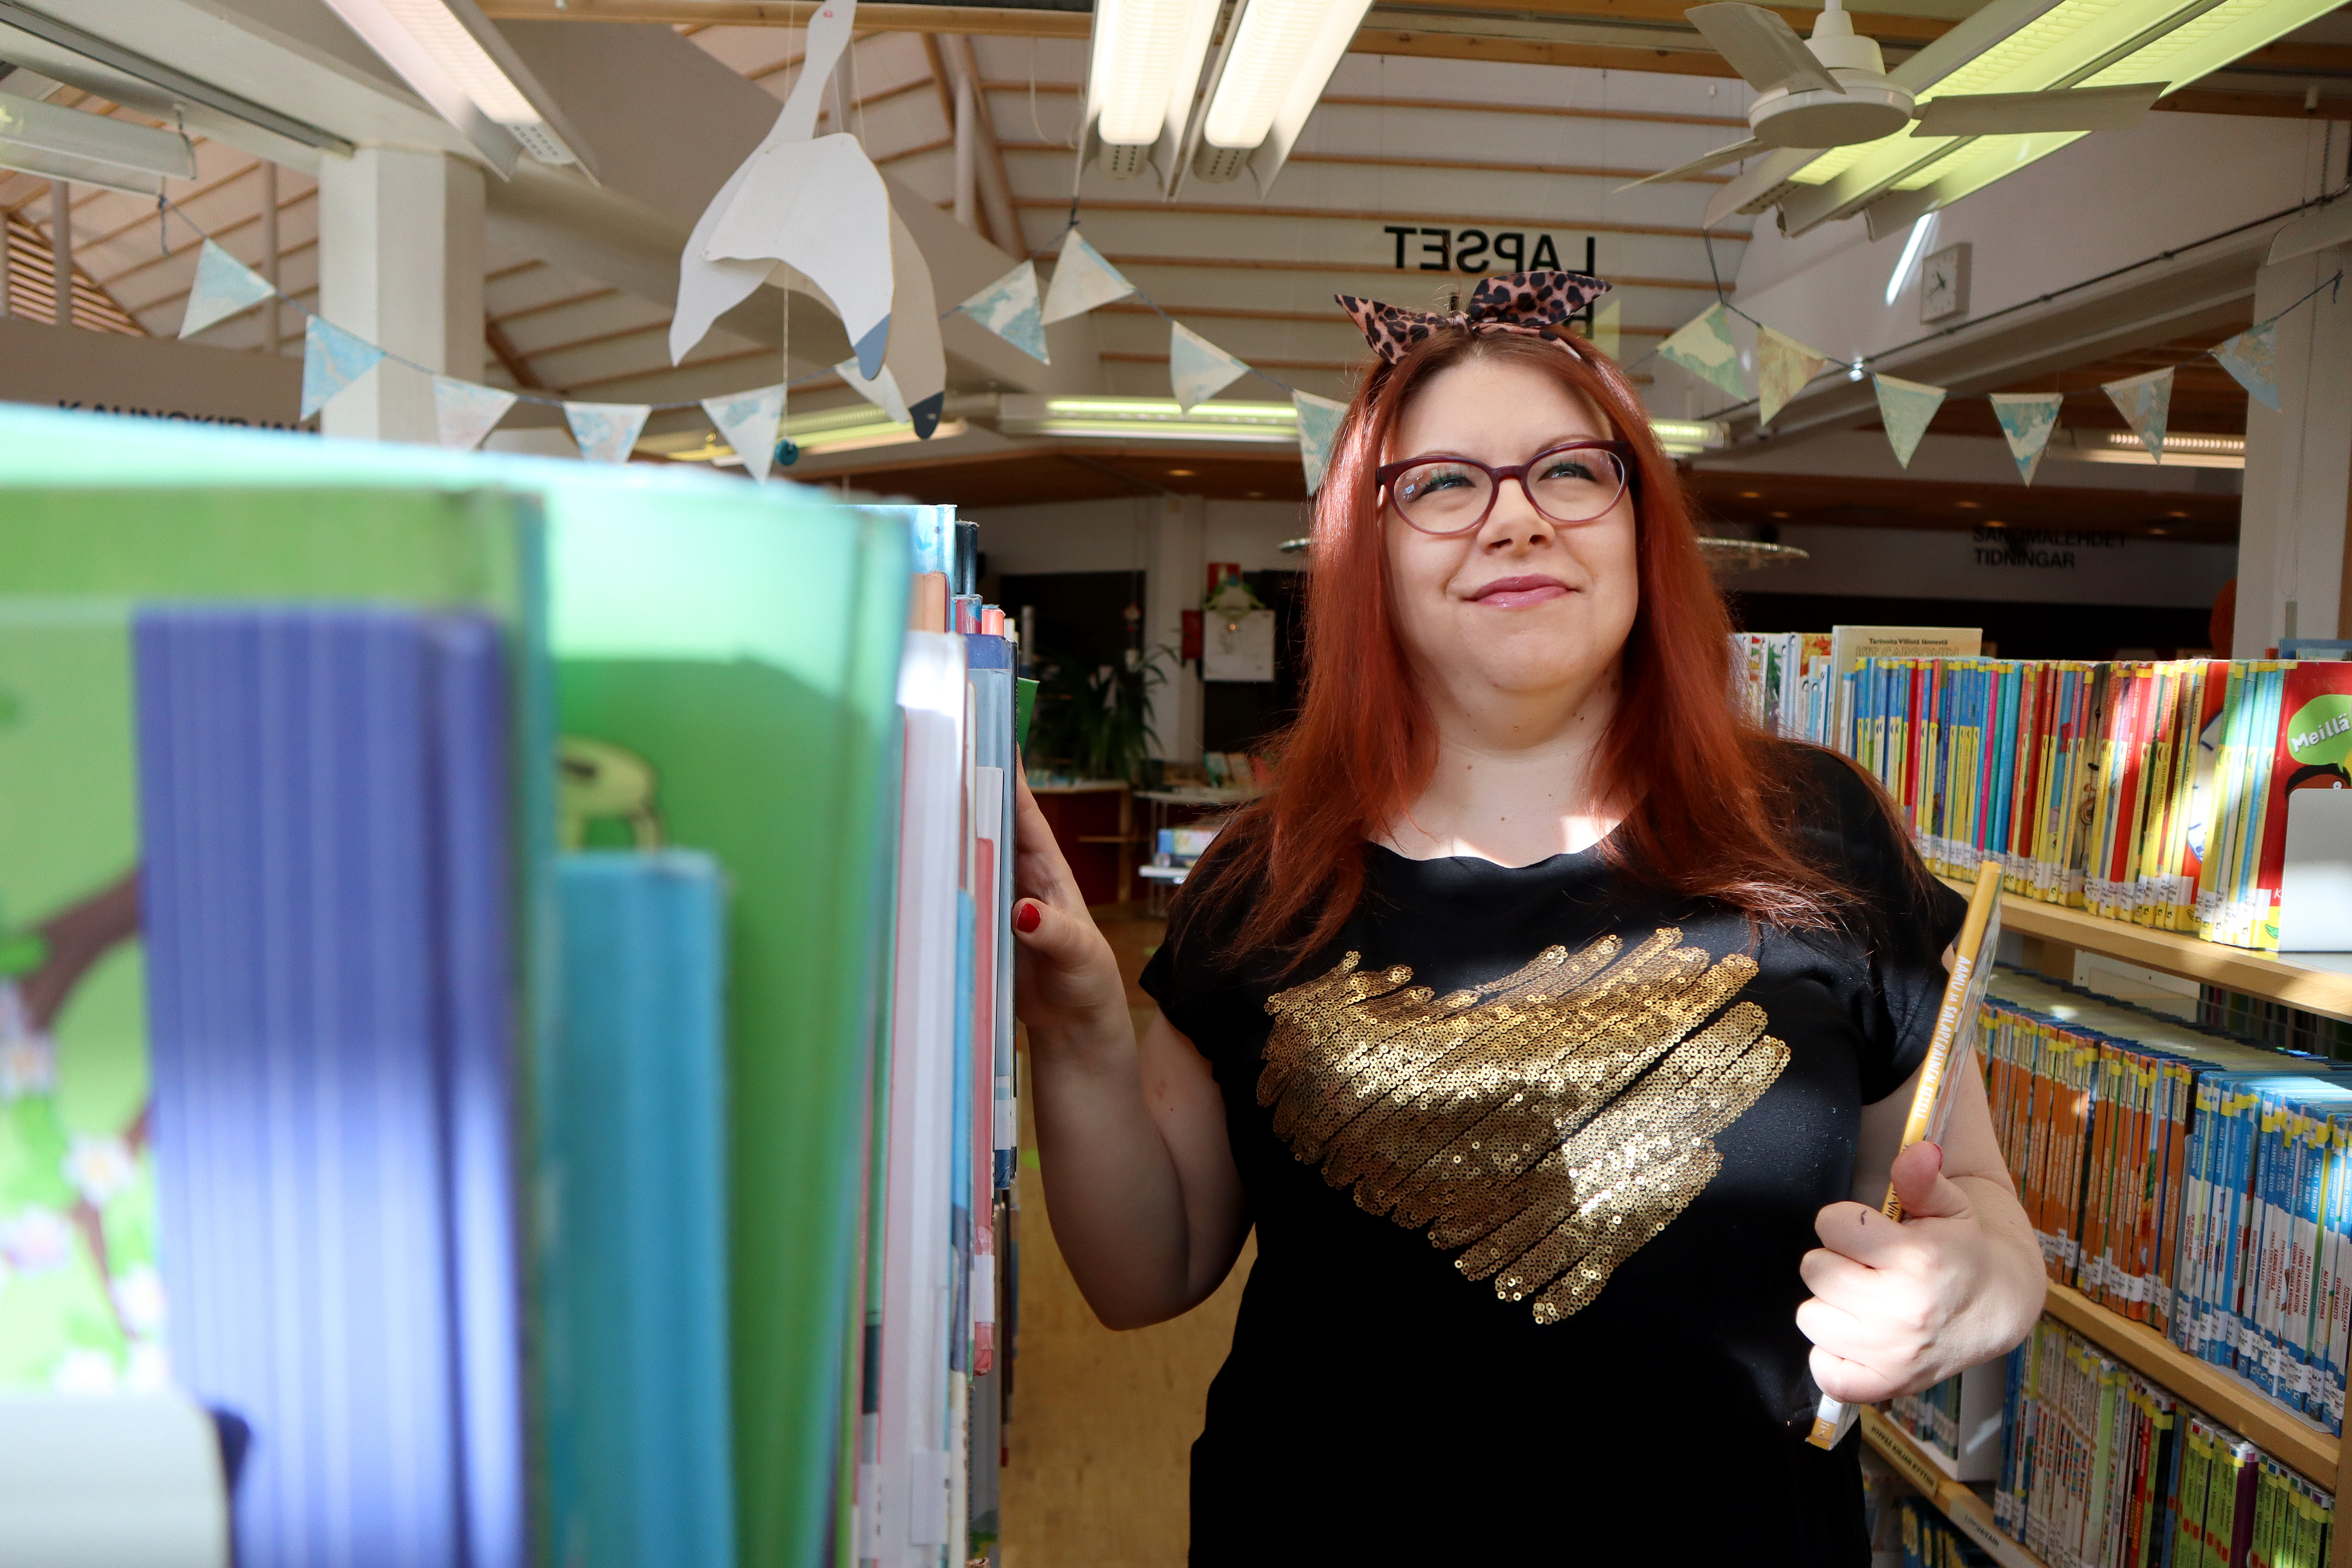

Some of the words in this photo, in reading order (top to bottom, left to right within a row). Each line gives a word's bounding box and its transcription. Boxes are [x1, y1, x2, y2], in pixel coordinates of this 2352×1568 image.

[1974, 548, 2075, 569] TIDNINGAR
[2291, 713, 2350, 752] Meillä
[1952, 955, 1971, 992] AAMU
[1949, 992, 1958, 1002] JA
[1926, 1004, 1957, 1083] SALAPERÄINEN
[1913, 1084, 1934, 1119] SETELI
[2342, 1194, 2350, 1222] WILLIAMS
[1824, 1398, 1835, 1407] RIL
